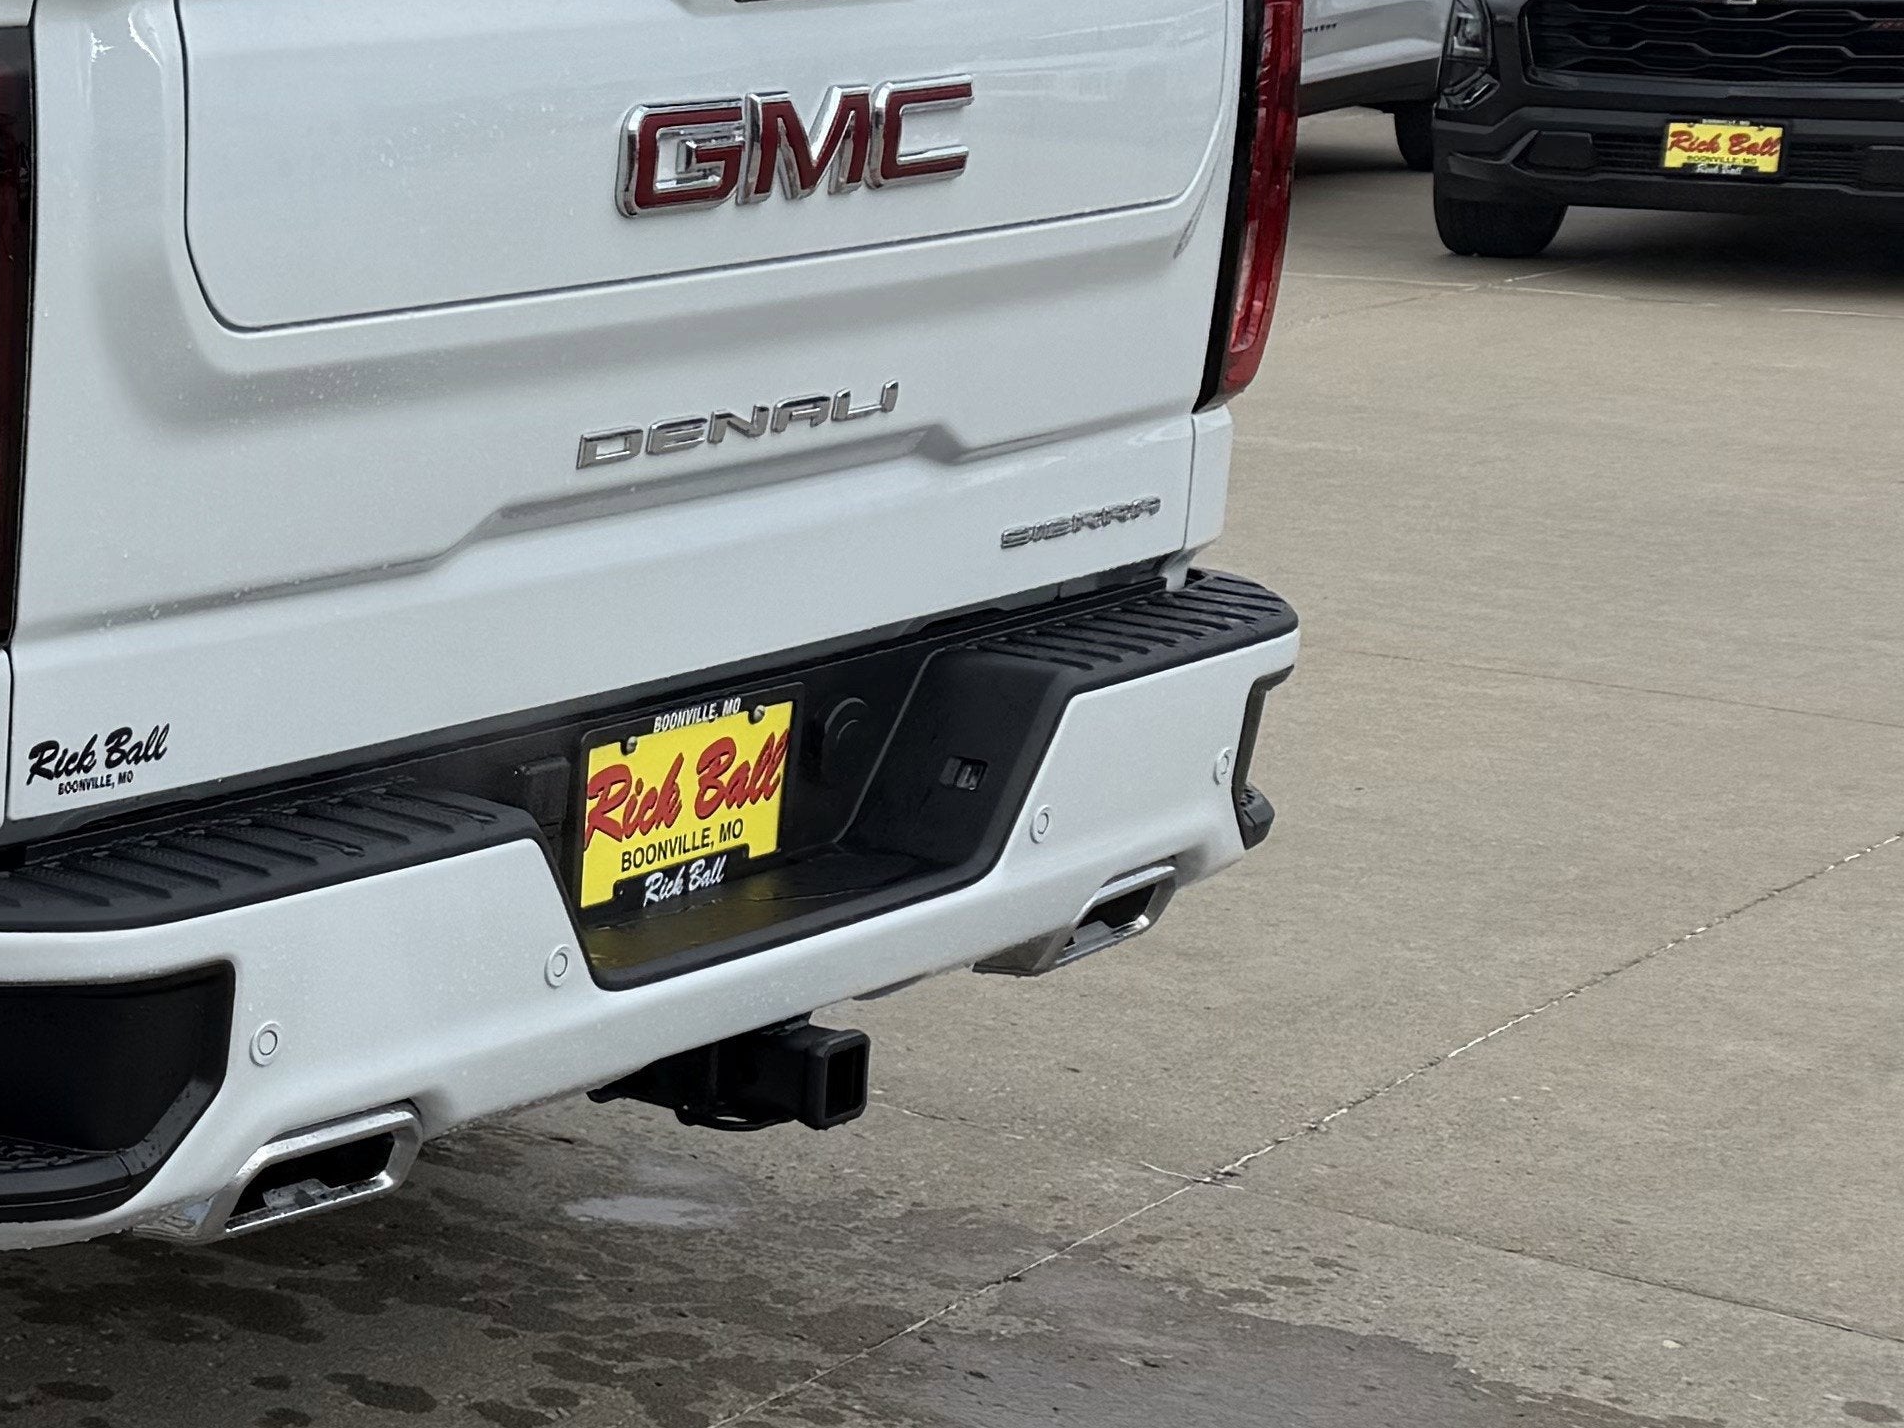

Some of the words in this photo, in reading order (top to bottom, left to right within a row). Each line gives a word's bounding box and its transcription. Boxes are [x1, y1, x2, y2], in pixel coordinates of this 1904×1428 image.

[614, 73, 975, 219] GMC
[1668, 130, 1722, 154] Rick
[1728, 132, 1782, 157] Ball
[575, 378, 900, 470] DENALI
[1000, 494, 1162, 549] SIERRA
[653, 703, 718, 733] BOONVILLE,
[721, 697, 742, 716] MO
[26, 734, 99, 786] Rick
[104, 722, 171, 770] Ball
[58, 773, 116, 796] BOONVILLE,
[117, 770, 134, 785] MO
[583, 752, 685, 851] Rick
[694, 728, 791, 821] Ball
[621, 826, 715, 873] BOONVILLE,
[719, 818, 744, 844] MO
[642, 862, 685, 908] Rick
[688, 854, 728, 893] Ball
